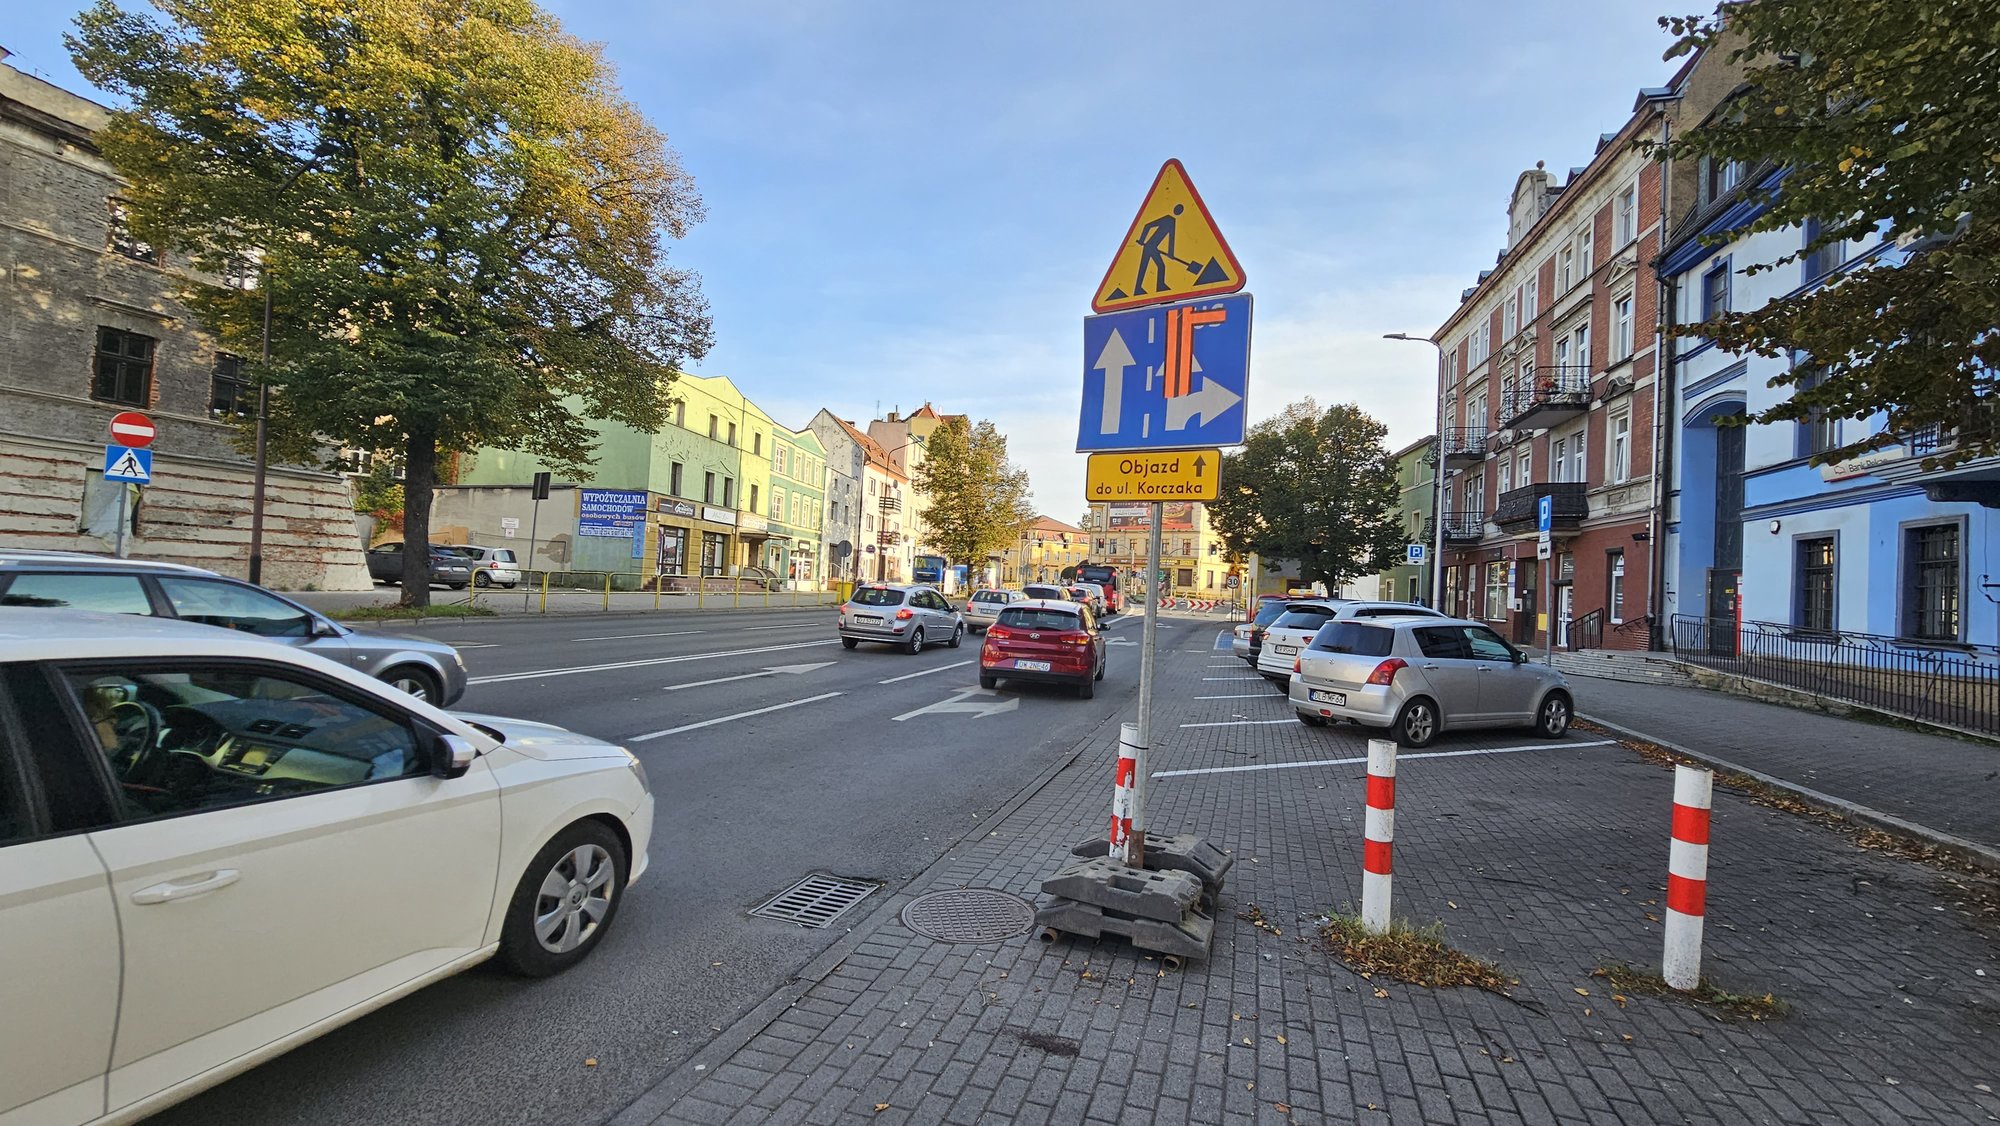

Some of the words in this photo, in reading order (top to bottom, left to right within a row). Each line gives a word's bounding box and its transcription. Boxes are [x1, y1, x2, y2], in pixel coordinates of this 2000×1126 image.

[1119, 457, 1180, 478] Objazd
[1848, 462, 1865, 472] Bank
[1096, 482, 1112, 495] do
[1117, 482, 1132, 495] ul.
[1137, 481, 1202, 495] Korczaka
[582, 492, 646, 505] WYPOŻYCZALNIA
[581, 504, 634, 513] SAMOCHODÓW
[581, 512, 621, 520] osobowych
[622, 513, 646, 521] busów
[1227, 578, 1238, 586] 30
